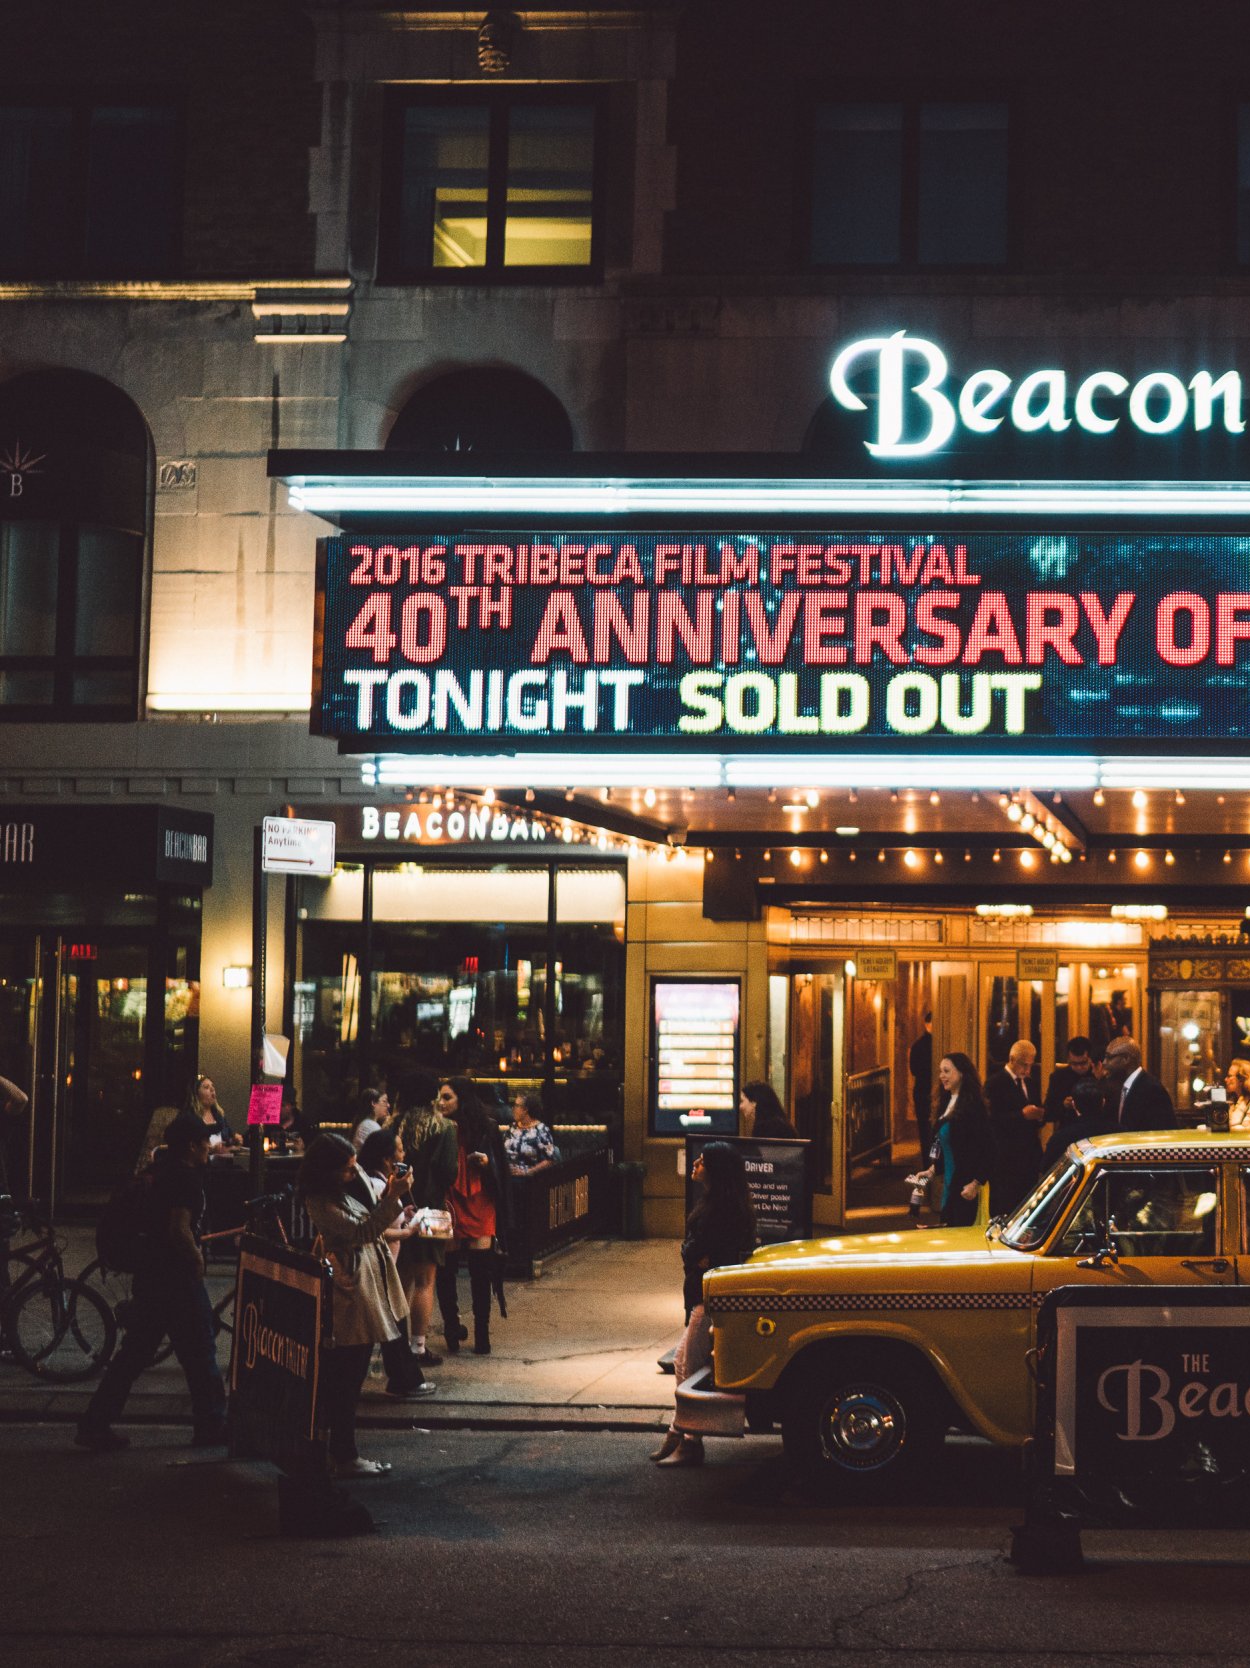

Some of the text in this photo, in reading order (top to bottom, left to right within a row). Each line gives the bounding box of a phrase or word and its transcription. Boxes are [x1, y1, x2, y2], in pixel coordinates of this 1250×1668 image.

[829, 329, 1247, 458] Beacon
[10, 473, 23, 497] B
[349, 543, 982, 586] 2016 TRIBECA FILM FESTIVAL
[529, 588, 1136, 666] ANNIVERSARY
[342, 668, 1043, 736] TONIGHT SOLD OUT
[0, 822, 35, 863] AR
[267, 823, 280, 834] NO
[745, 1161, 774, 1173] DRIVER
[1181, 1353, 1211, 1373] THE
